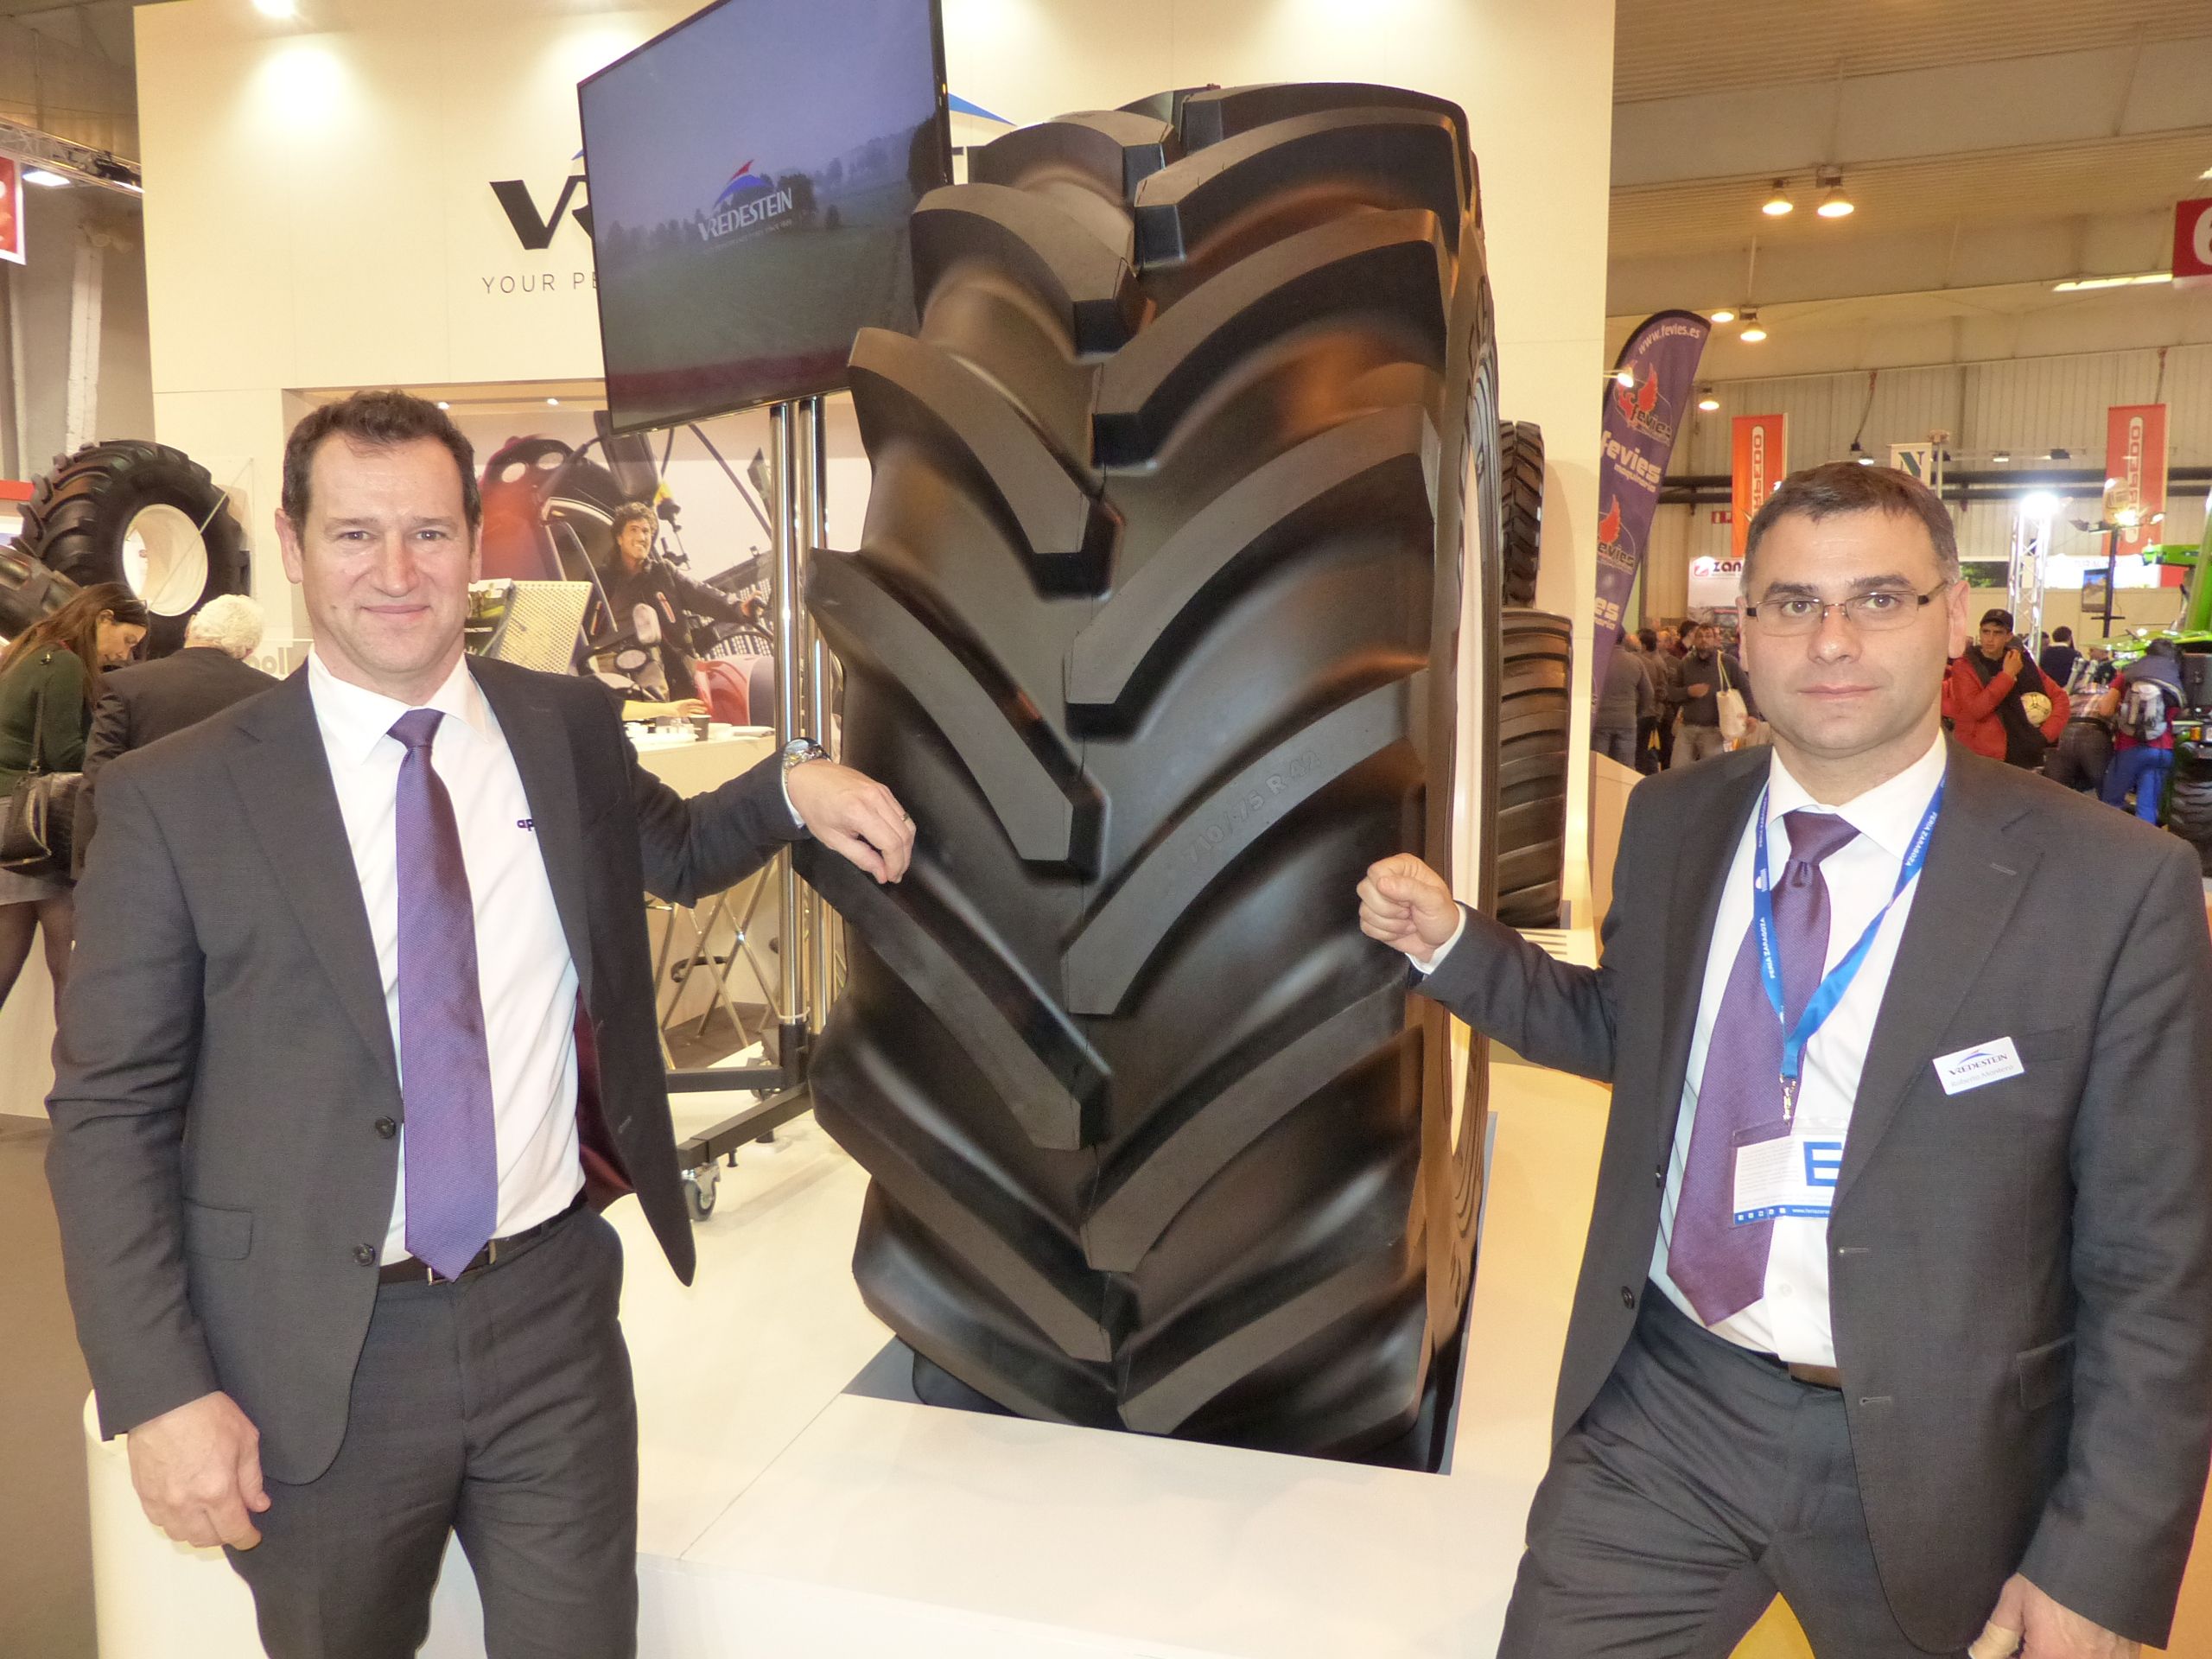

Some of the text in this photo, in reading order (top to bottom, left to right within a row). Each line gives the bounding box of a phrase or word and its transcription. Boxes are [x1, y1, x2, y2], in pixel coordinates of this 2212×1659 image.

[697, 187, 793, 242] VREDESTEIN
[481, 273, 556, 294] YOUR
[1637, 323, 1701, 355] www.fevies.es
[1600, 430, 1662, 485] fevies
[1759, 917, 1771, 957] ZARAGOZA
[1948, 1053, 2009, 1076] VREDESTEIN
